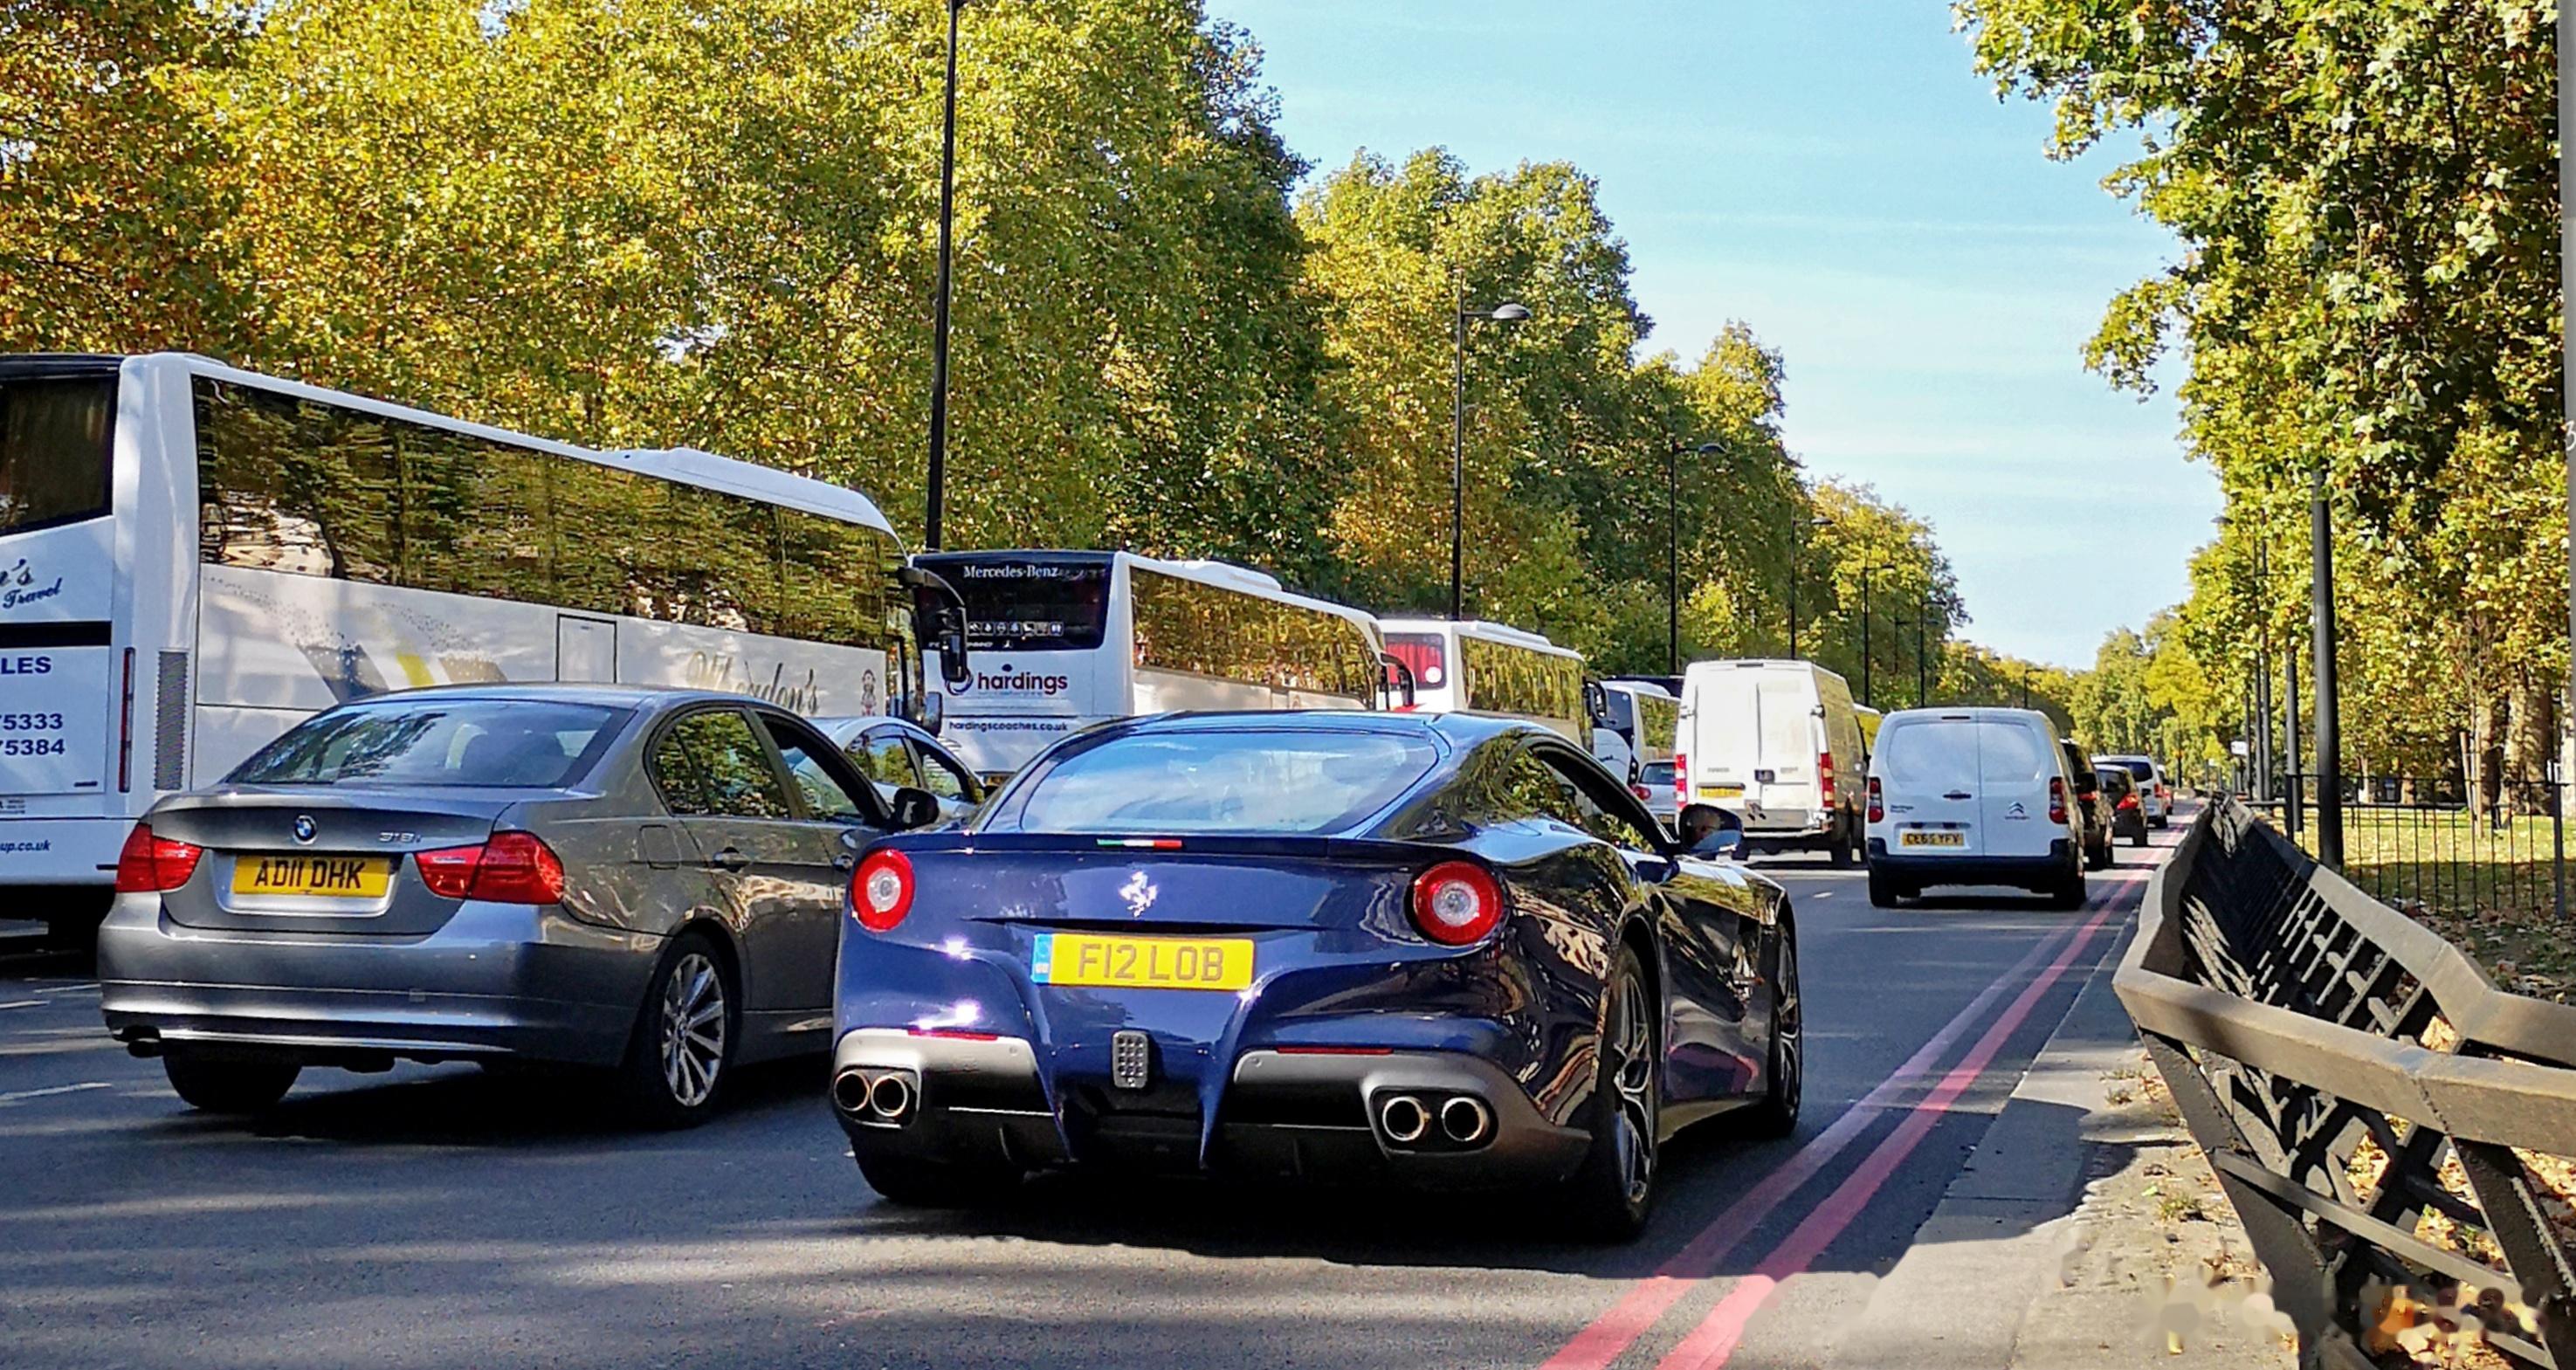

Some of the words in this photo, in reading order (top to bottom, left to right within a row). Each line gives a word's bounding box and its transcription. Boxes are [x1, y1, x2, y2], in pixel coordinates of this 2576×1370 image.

[3, 577, 63, 609] Travel
[1, 657, 52, 674] LES
[977, 671, 1068, 695] hardings
[0, 713, 63, 730] 5333
[949, 721, 1068, 732] hardingscoaches.co.uk
[0, 739, 65, 755] 5384
[253, 859, 303, 888] AD11
[309, 860, 366, 889] DHK
[1078, 943, 1137, 979] F12
[1148, 945, 1224, 981] LOB
